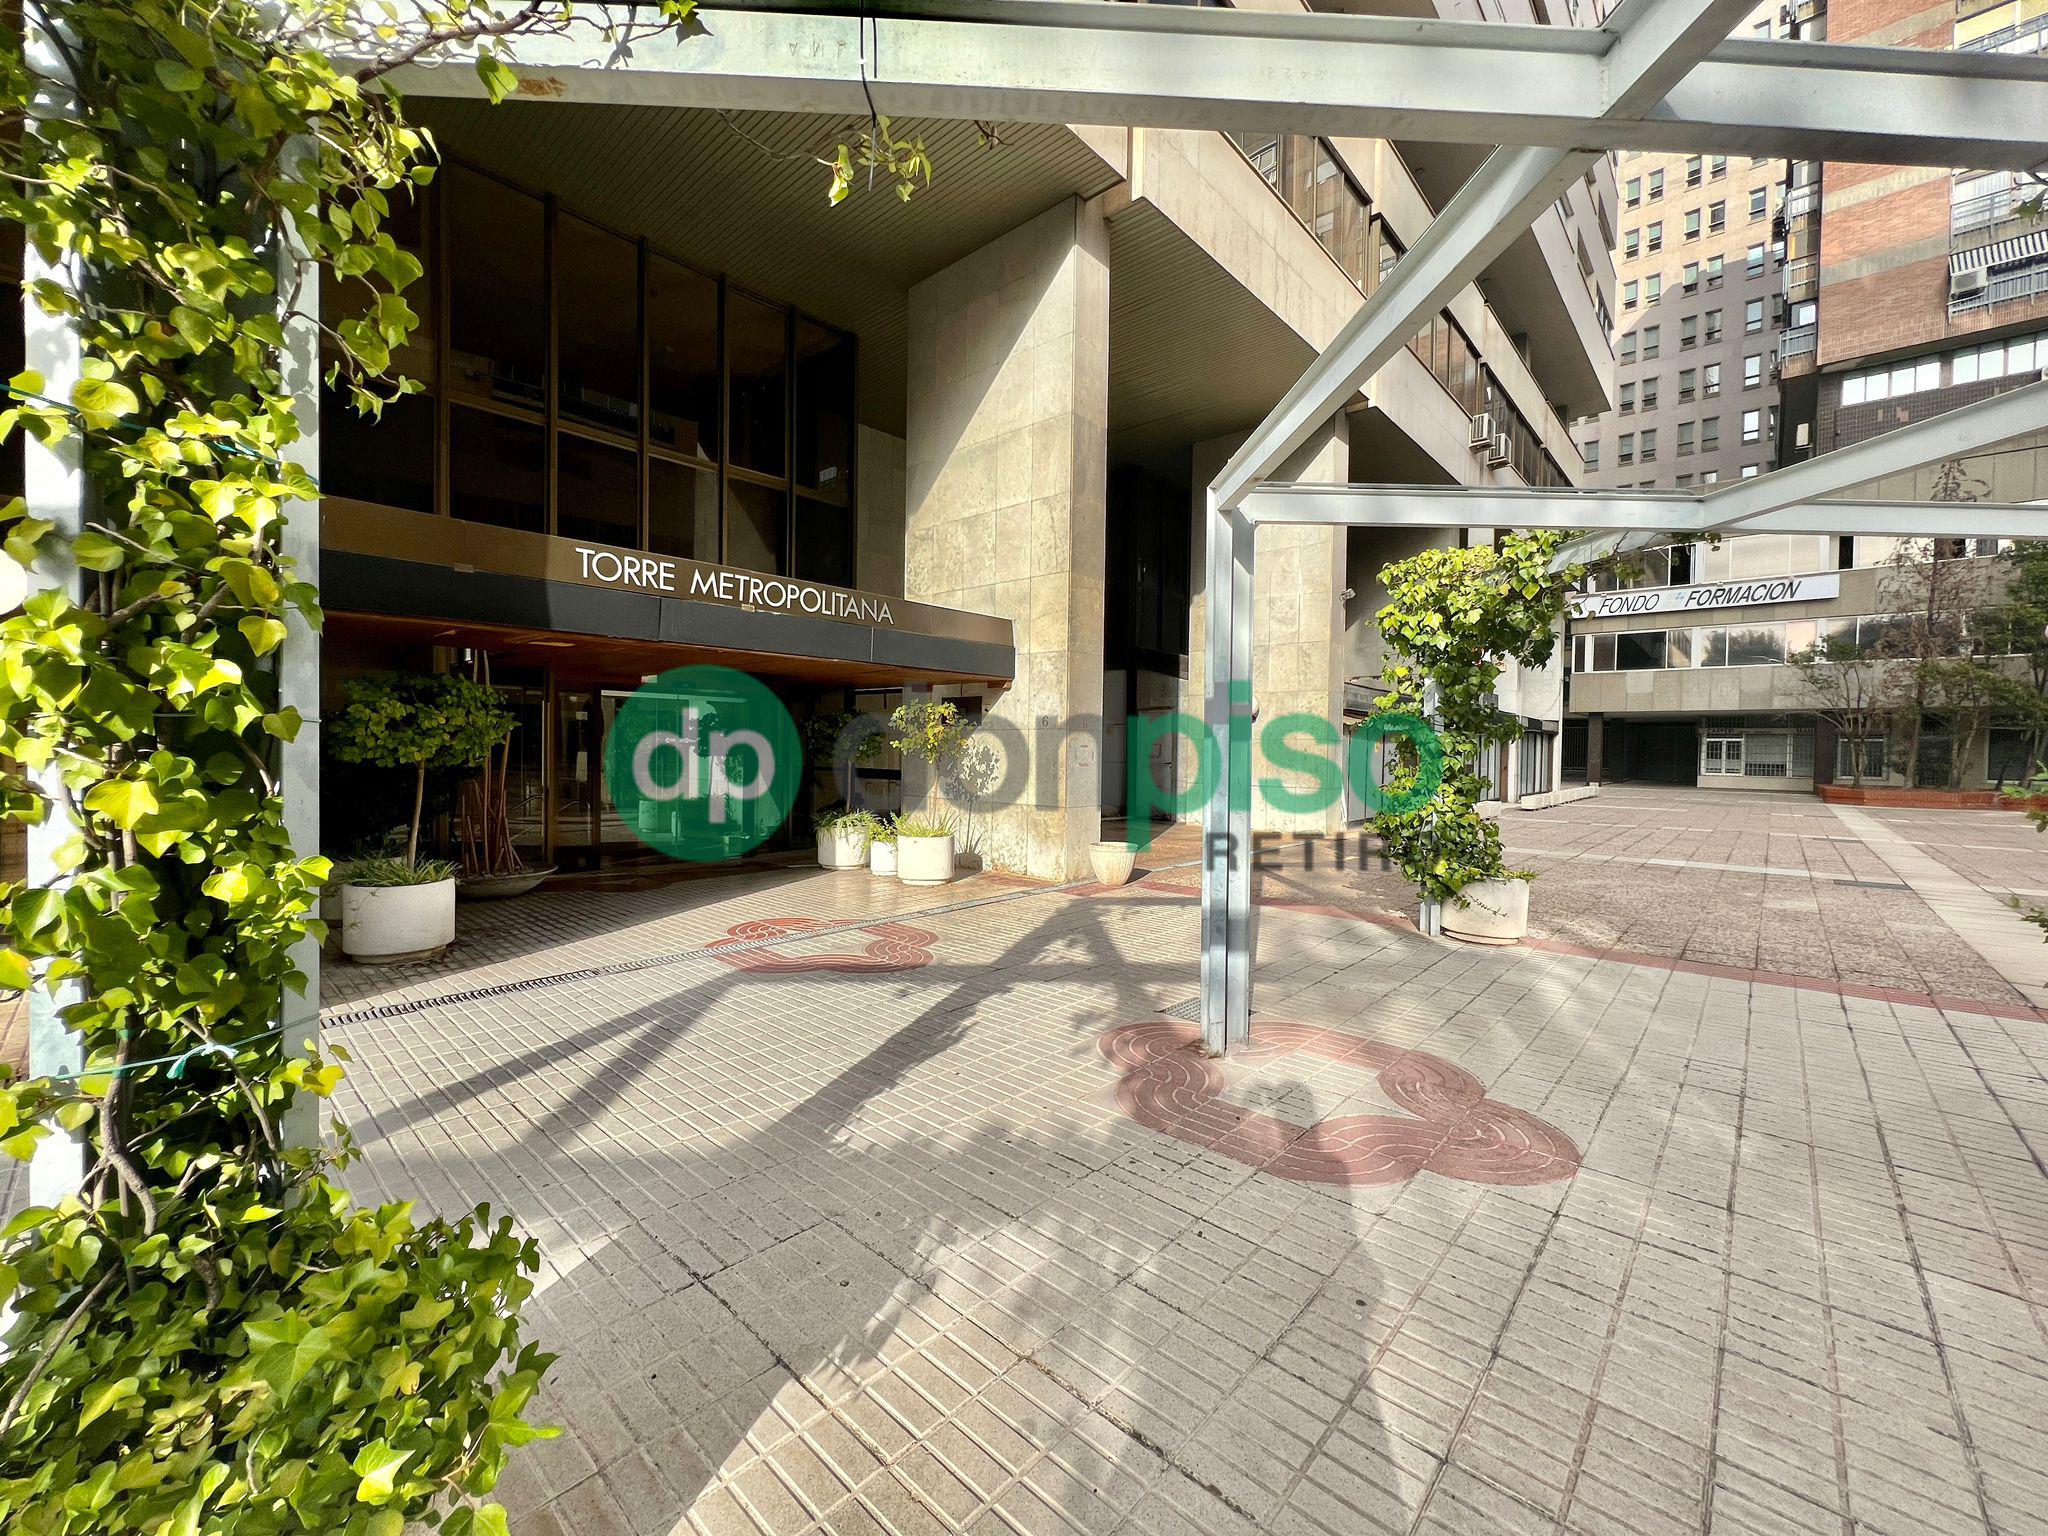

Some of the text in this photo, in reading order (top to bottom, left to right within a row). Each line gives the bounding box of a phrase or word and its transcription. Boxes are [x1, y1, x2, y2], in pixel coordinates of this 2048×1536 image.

[575, 547, 895, 625] TORRE METROPOLITANA
[1598, 581, 1802, 615] FONDO FORMACION
[1042, 715, 1050, 728] 6
